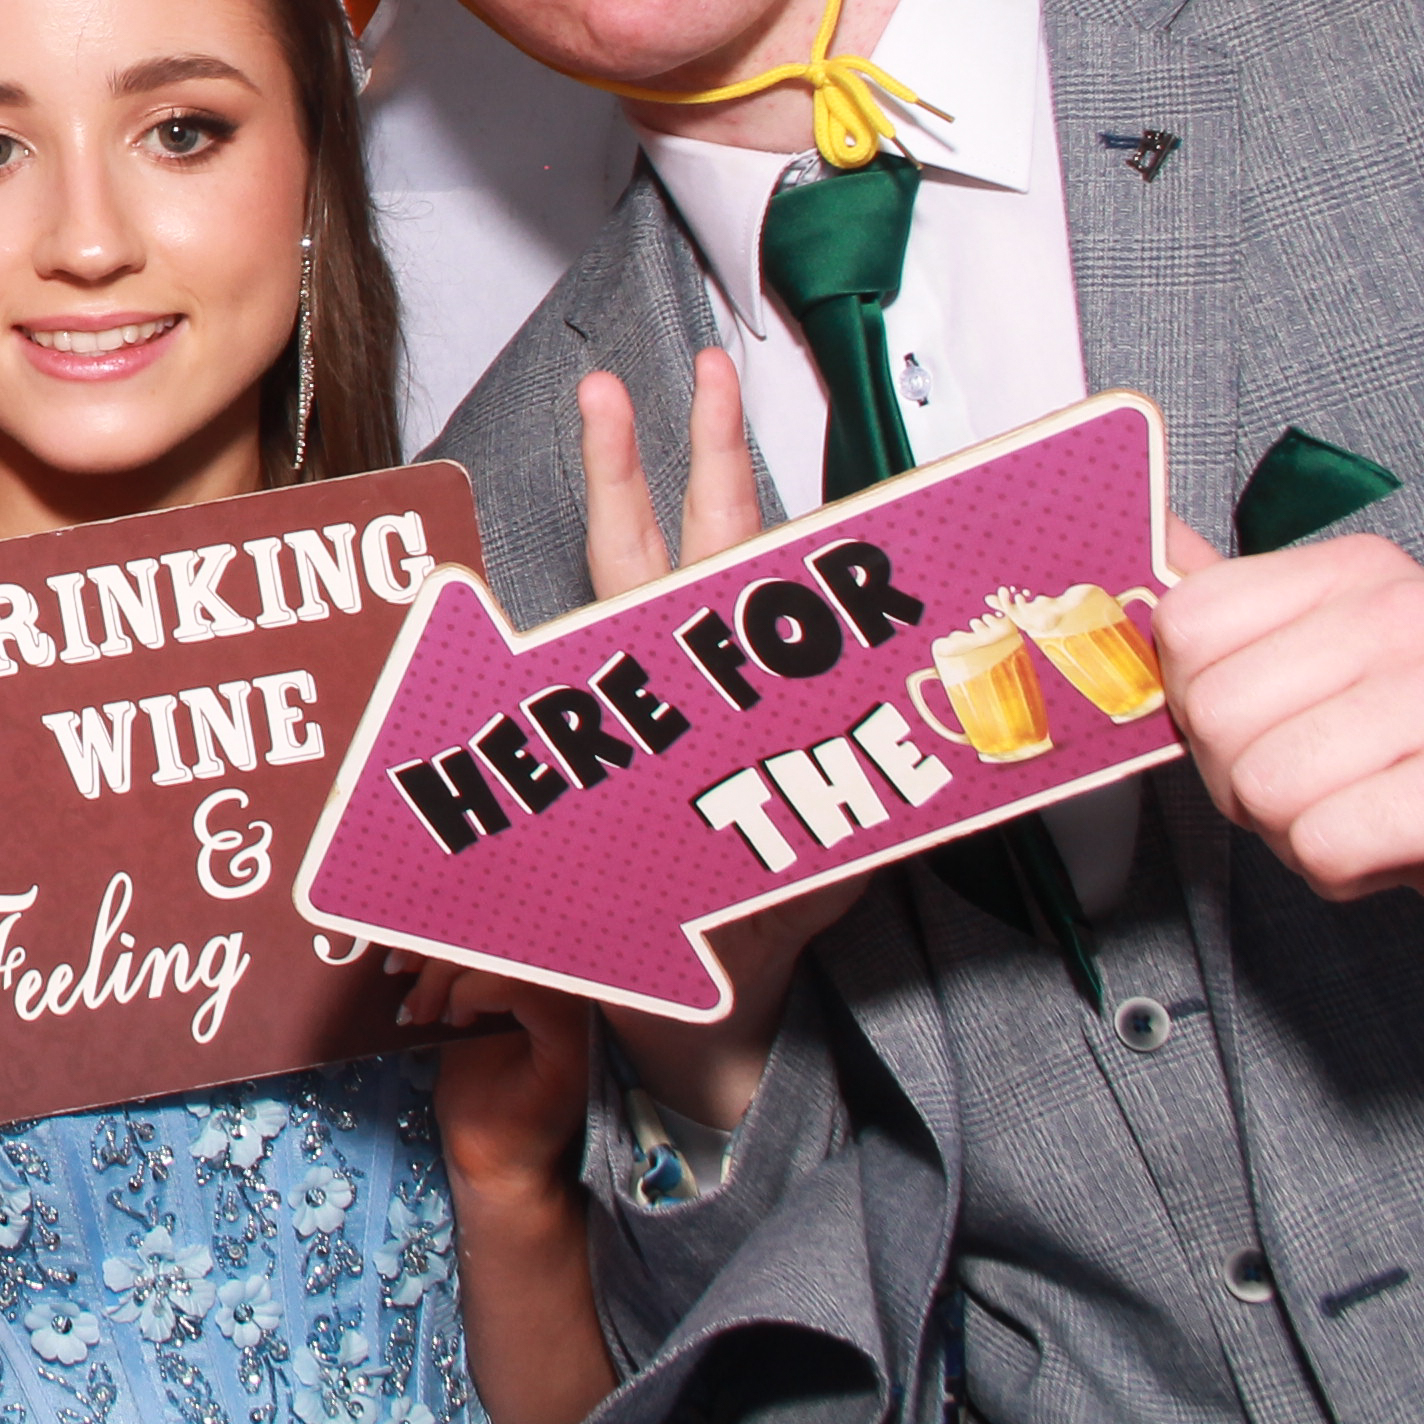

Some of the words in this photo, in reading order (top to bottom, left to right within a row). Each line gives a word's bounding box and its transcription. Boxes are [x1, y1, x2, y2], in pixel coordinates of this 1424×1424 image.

[42, 670, 325, 799] WINE
[386, 650, 692, 855] HERE
[672, 538, 926, 712] FOR
[193, 788, 272, 899] &
[692, 702, 954, 873] THE
